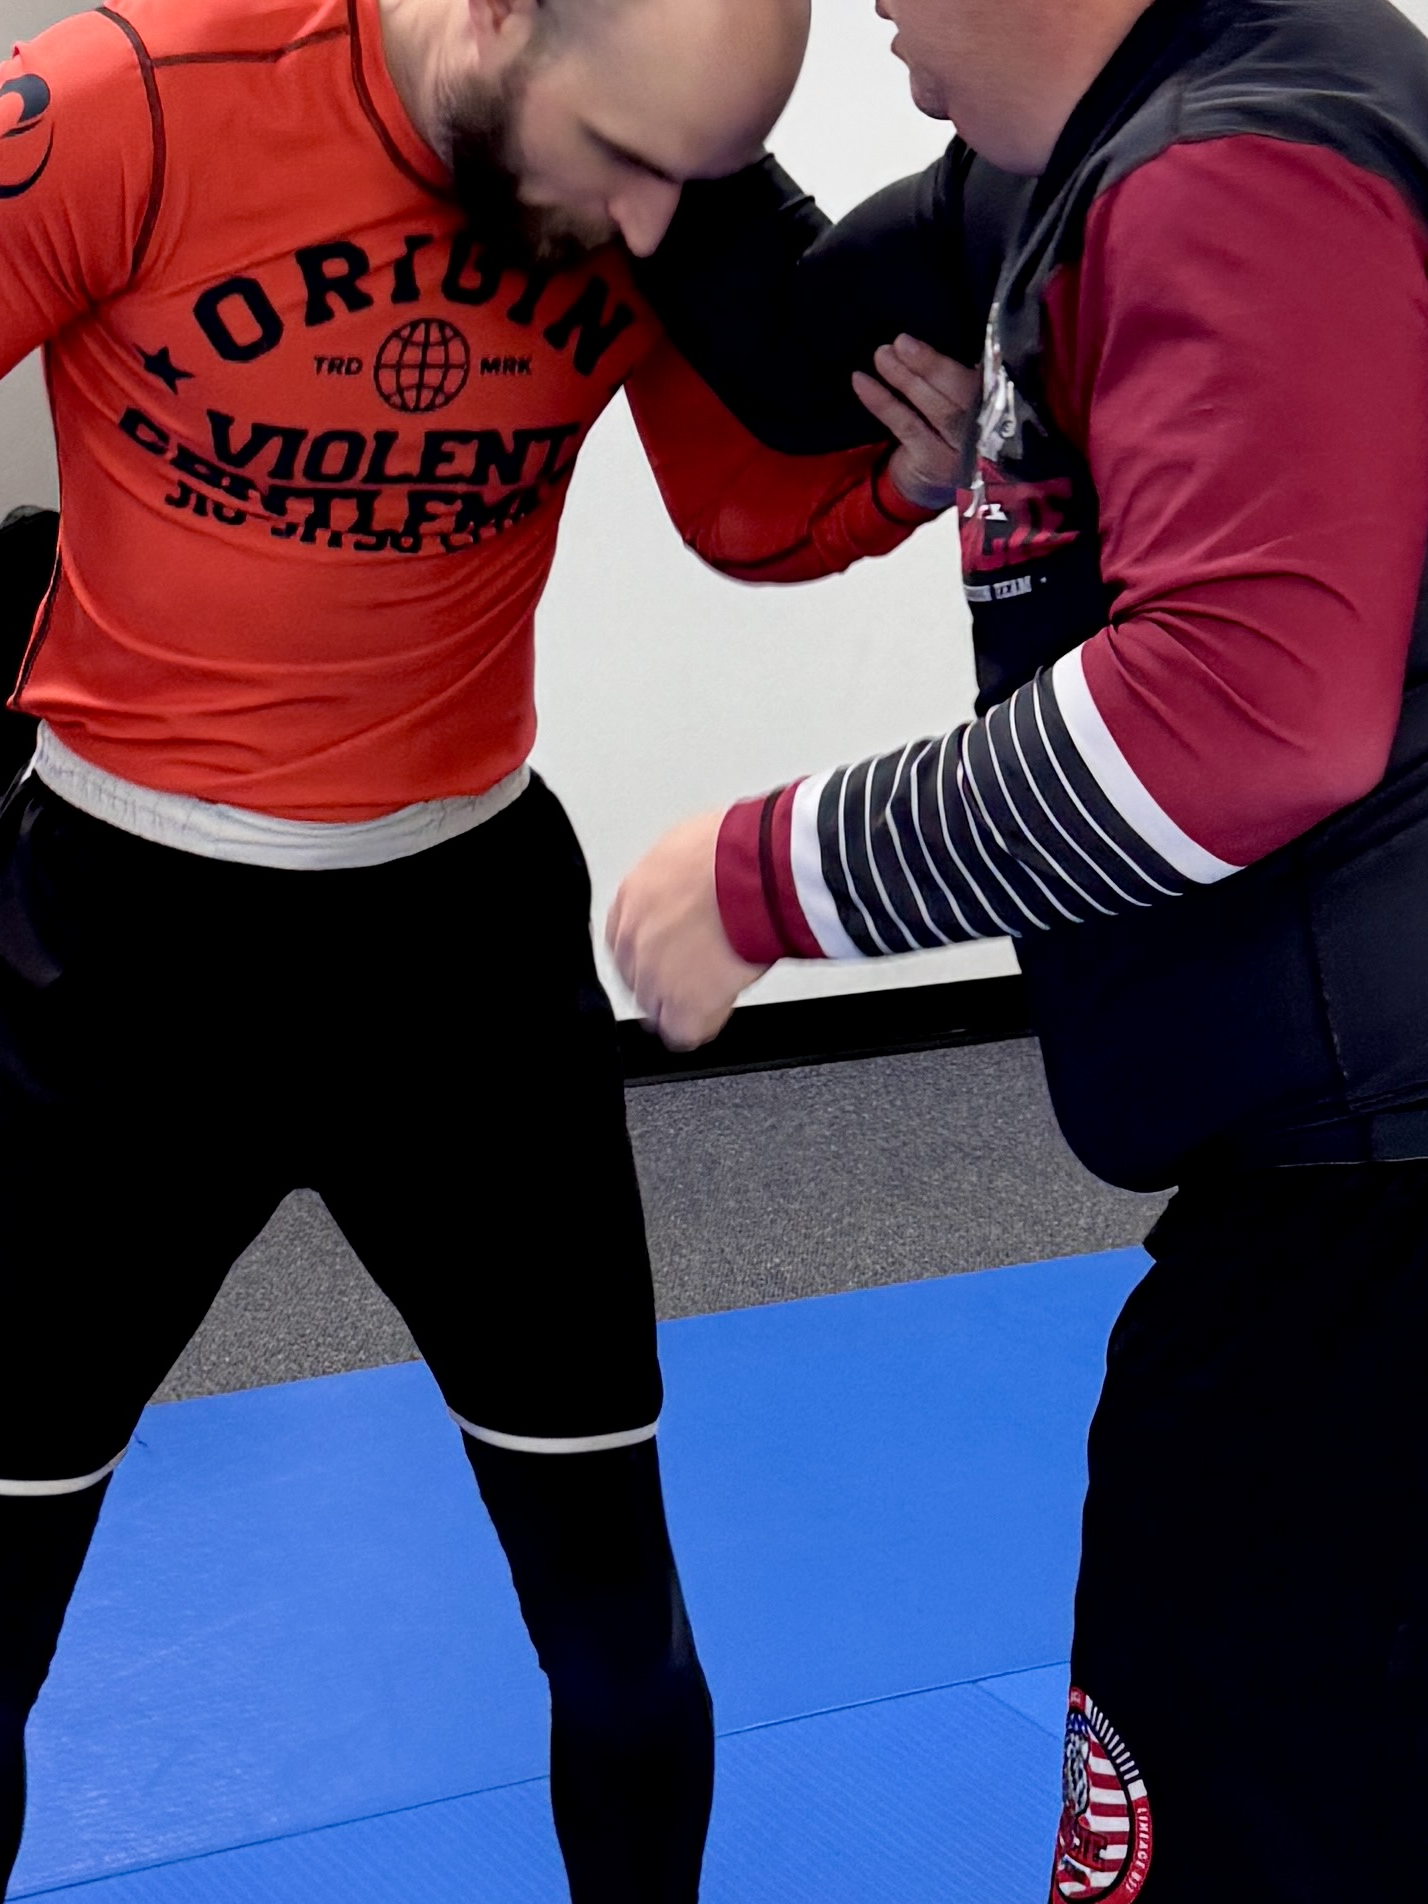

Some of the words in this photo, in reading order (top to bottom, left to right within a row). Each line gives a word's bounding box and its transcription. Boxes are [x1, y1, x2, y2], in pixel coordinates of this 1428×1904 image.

[192, 231, 635, 377] ORIGIN
[313, 355, 363, 377] TRD
[480, 355, 533, 376] MRK
[206, 408, 581, 485] VIOLENT
